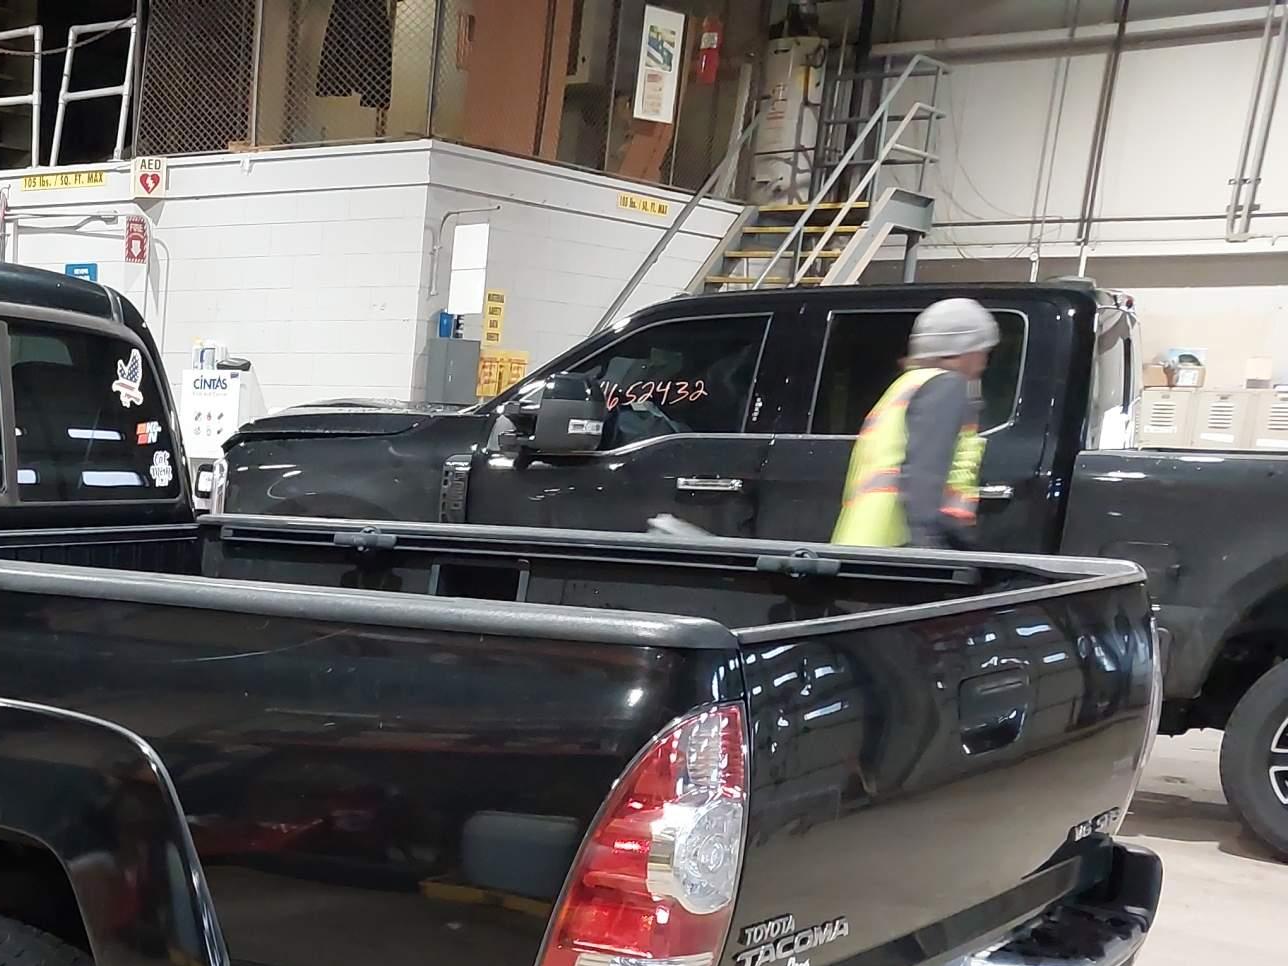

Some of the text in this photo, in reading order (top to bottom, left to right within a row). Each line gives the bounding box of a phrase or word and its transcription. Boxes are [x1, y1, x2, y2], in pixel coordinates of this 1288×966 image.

[140, 159, 161, 170] AED
[24, 177, 37, 189] 105
[39, 175, 51, 187] lbs.
[60, 174, 71, 186] SQ.
[74, 173, 84, 185] FT.
[87, 172, 103, 183] MAX
[129, 223, 144, 233] FIRE
[193, 375, 228, 390] CINTAS
[745, 914, 795, 946] TOYOTA
